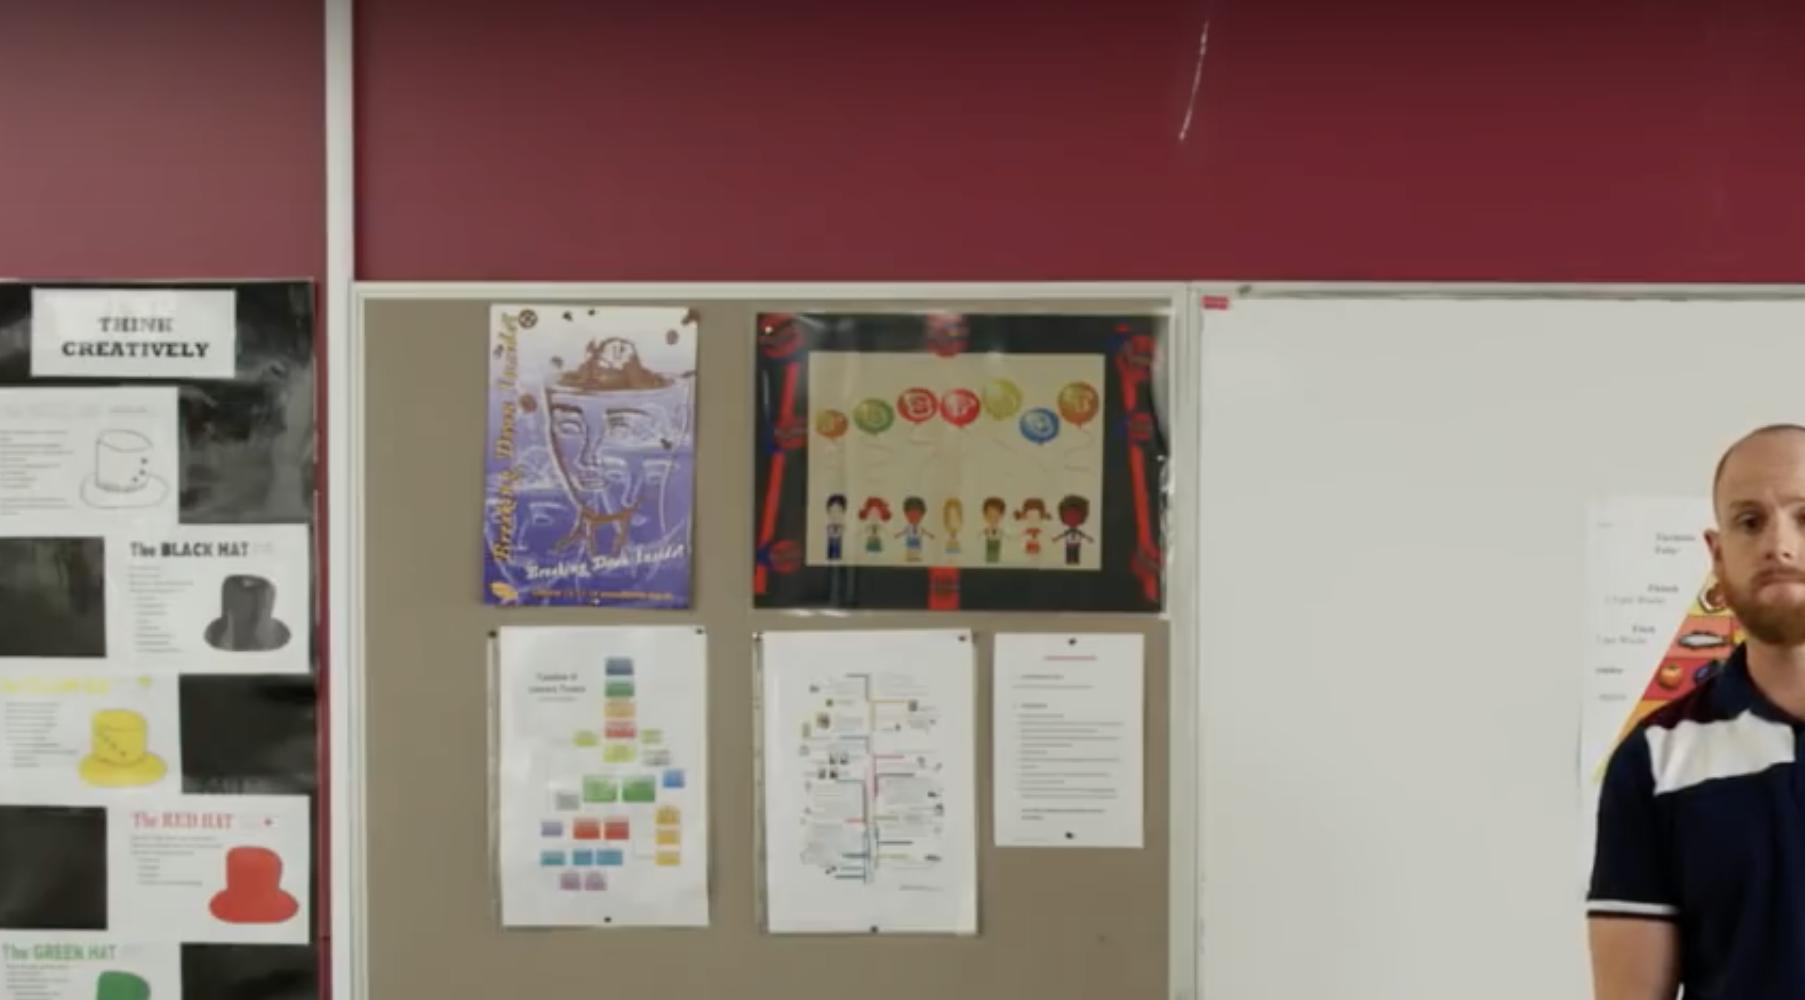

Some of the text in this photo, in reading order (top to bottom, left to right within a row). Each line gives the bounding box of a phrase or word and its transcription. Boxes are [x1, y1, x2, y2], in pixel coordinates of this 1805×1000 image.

[98, 316, 174, 333] THINK
[61, 340, 210, 358] CREATIVELY
[130, 541, 249, 558] The BLACK HAT
[131, 812, 234, 830] The RED HAT
[2, 942, 118, 961] The GREEN HAT
